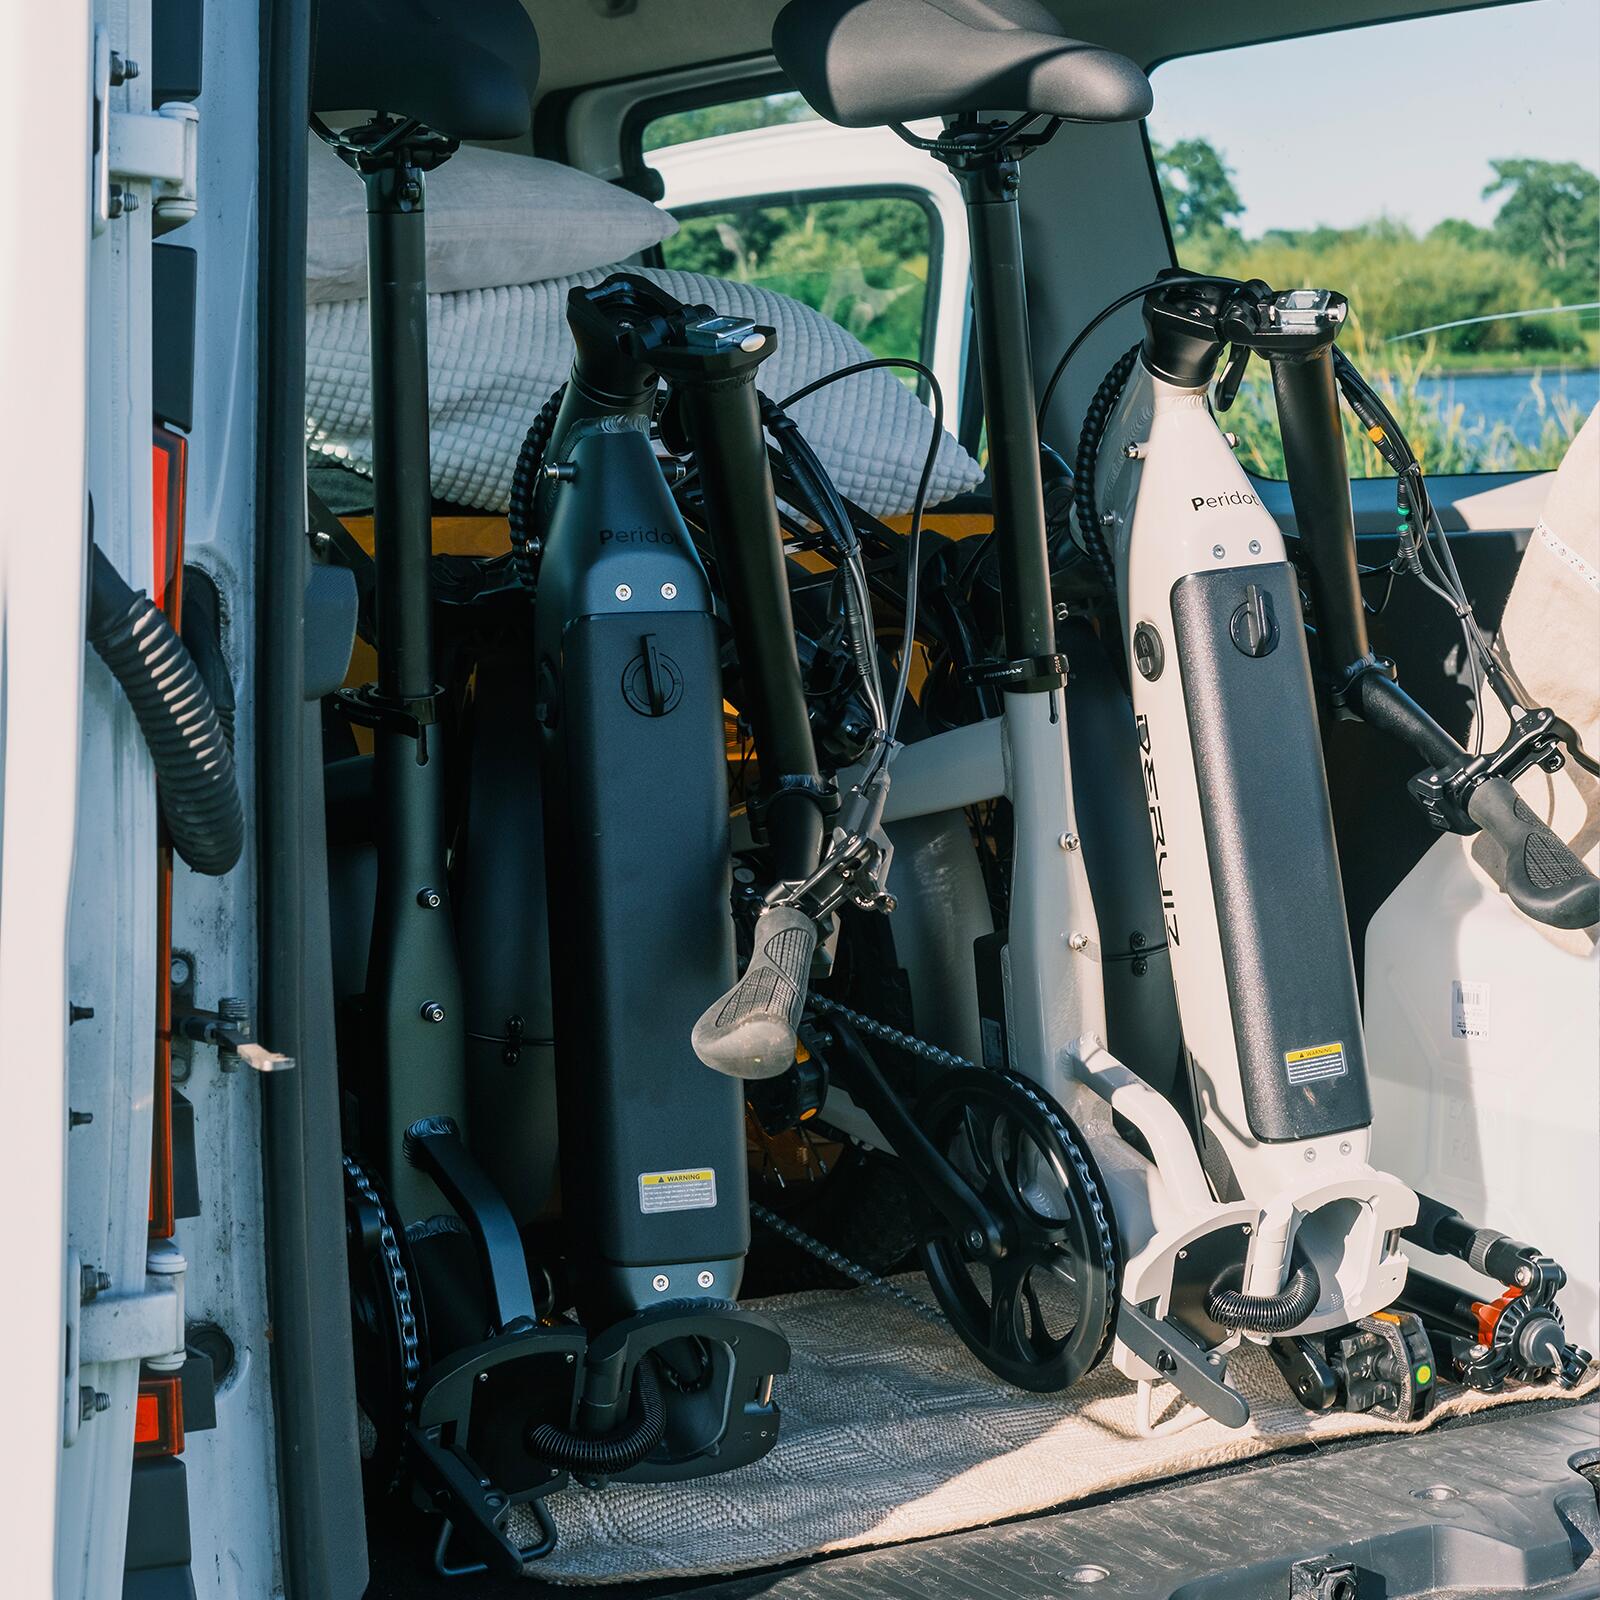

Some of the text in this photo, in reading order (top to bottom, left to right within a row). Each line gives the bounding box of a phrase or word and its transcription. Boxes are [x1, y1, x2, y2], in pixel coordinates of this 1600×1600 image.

[1191, 491, 1260, 512] Peridot
[1306, 1048, 1332, 1056] WARNING
[667, 1174, 700, 1182] WARNING
